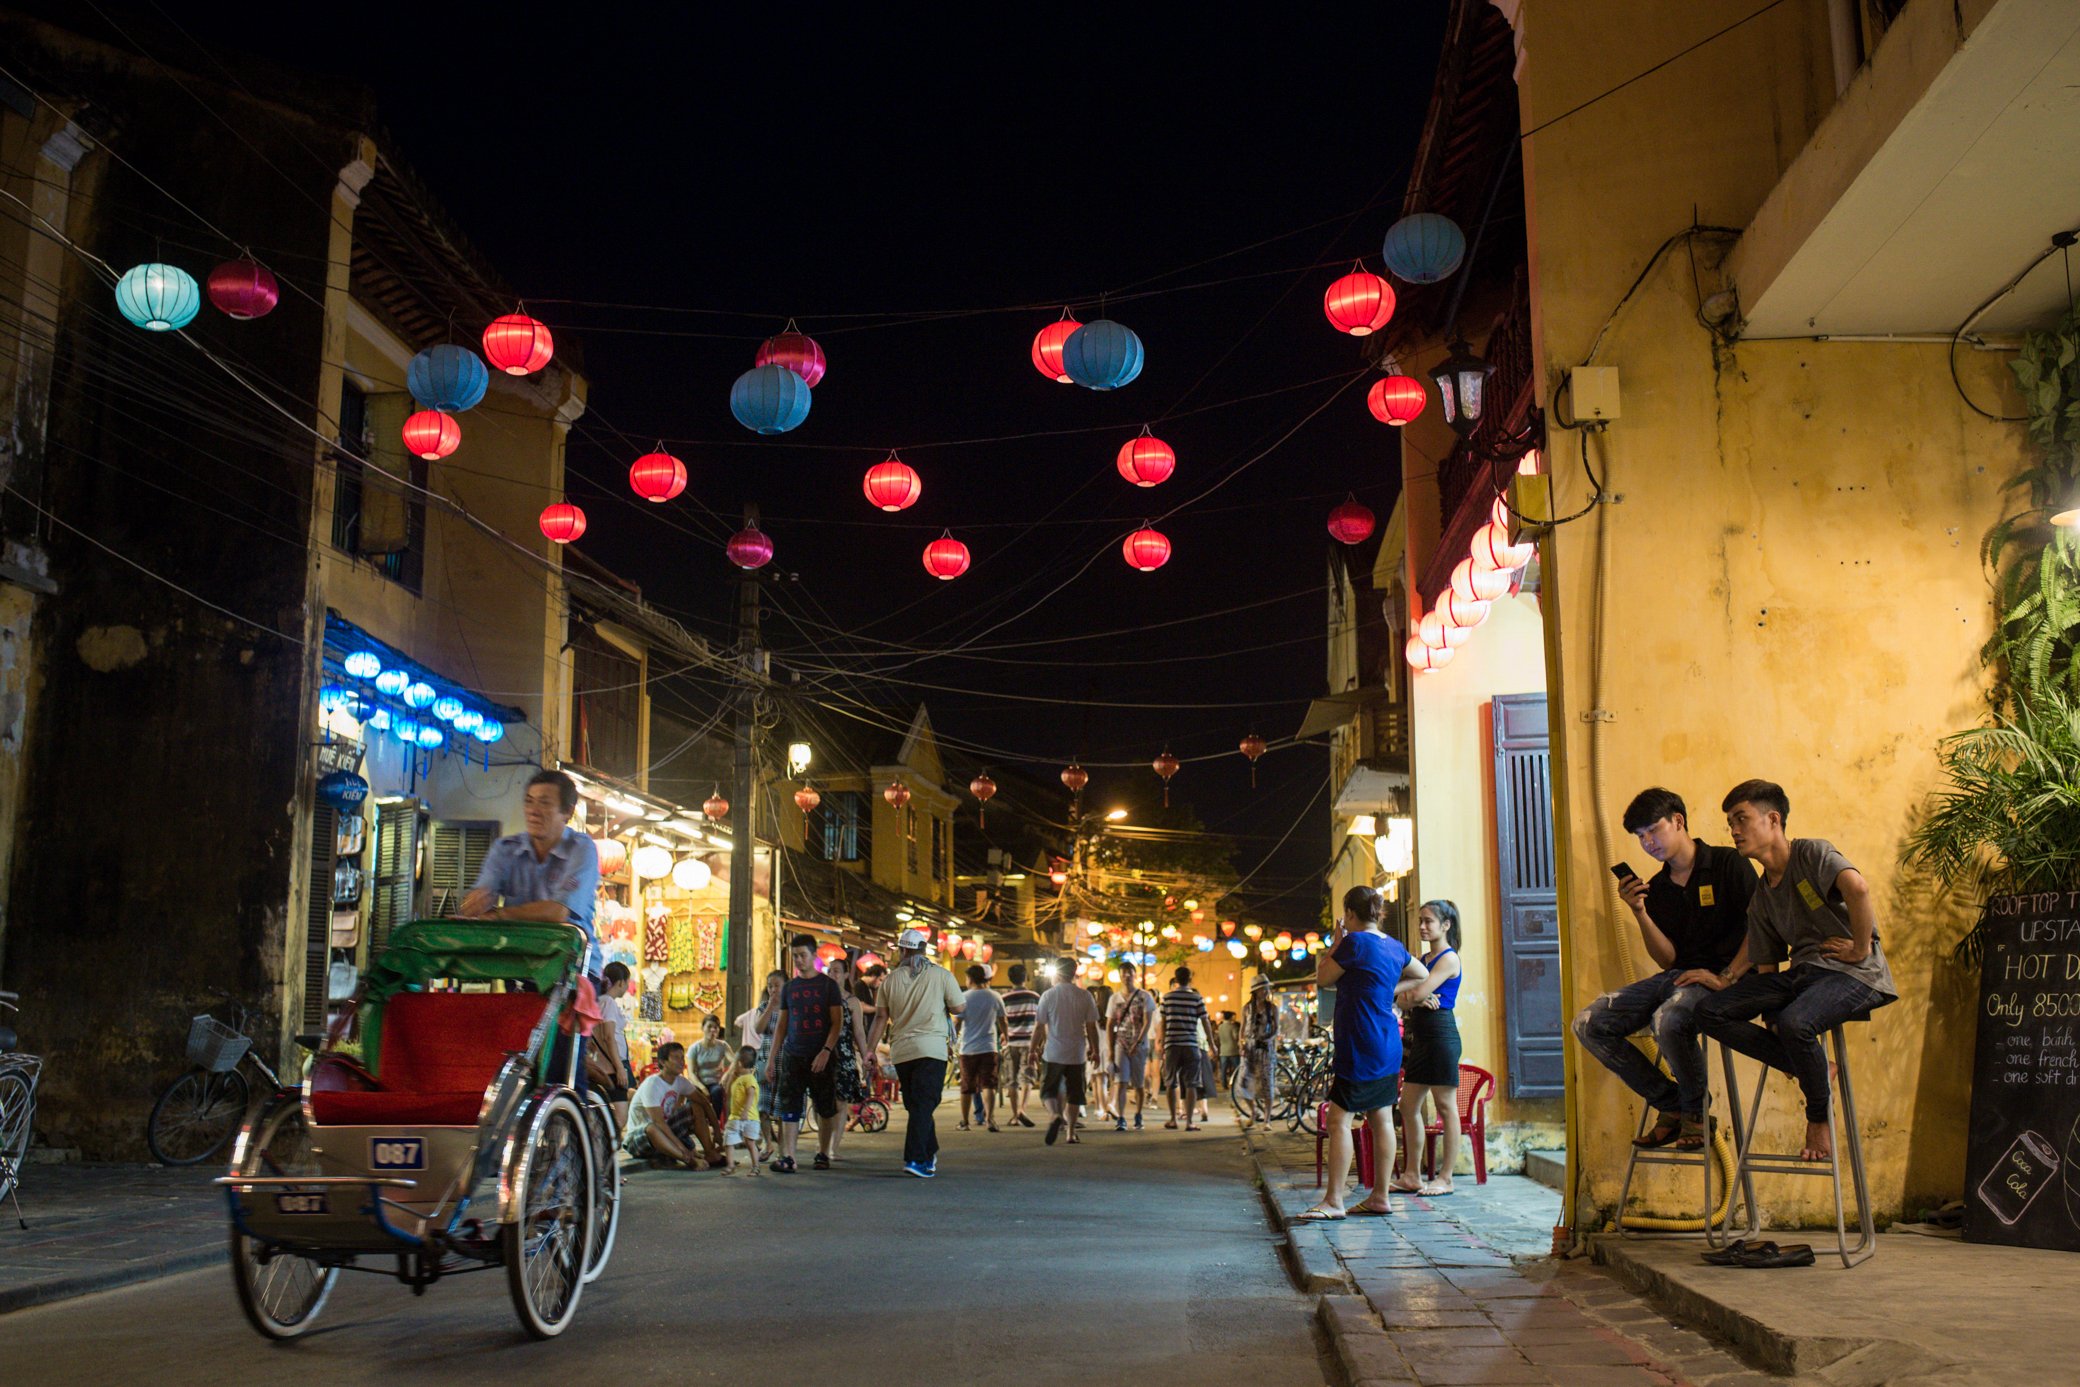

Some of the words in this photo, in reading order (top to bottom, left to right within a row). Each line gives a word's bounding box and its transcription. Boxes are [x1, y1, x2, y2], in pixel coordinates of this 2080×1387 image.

[1991, 891, 2060, 916] ROOFTOP
[2021, 920, 2080, 941] UPSTA
[2005, 954, 2057, 980] HOT
[1987, 992, 2024, 1027] Only
[2006, 1054, 2031, 1065] one
[2038, 1048, 2080, 1068] french
[2003, 1071, 2029, 1084] one
[2035, 1069, 2062, 1085] soft
[375, 1143, 419, 1164] 087
[2012, 1150, 2032, 1175] Coca
[2006, 1173, 2028, 1199] Cola
